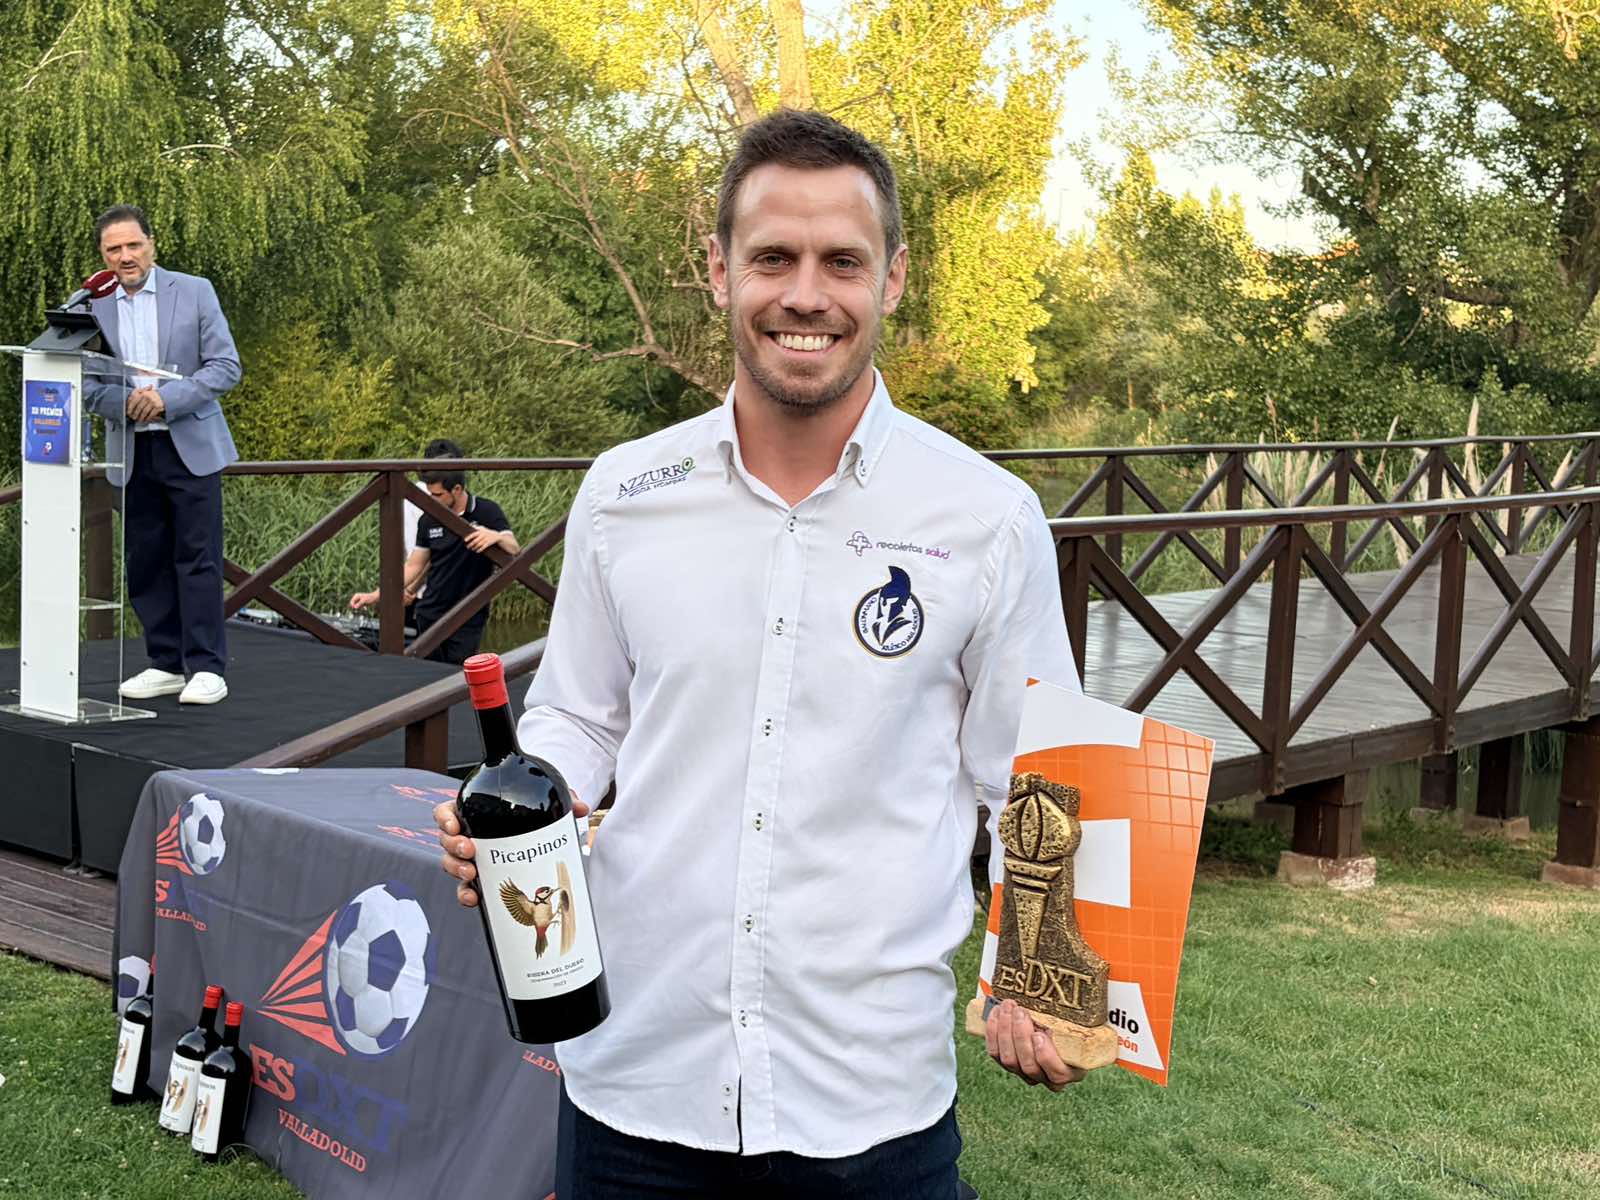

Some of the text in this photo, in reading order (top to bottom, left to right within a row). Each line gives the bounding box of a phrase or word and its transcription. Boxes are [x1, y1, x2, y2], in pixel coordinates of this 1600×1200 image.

[617, 457, 694, 496] AZZURRO
[876, 541, 951, 560] recoletas salud
[490, 834, 568, 865] Picapinos
[1109, 1008, 1139, 1034] dio
[1117, 1035, 1138, 1053] eón
[279, 1107, 367, 1173] VALLADOLID
